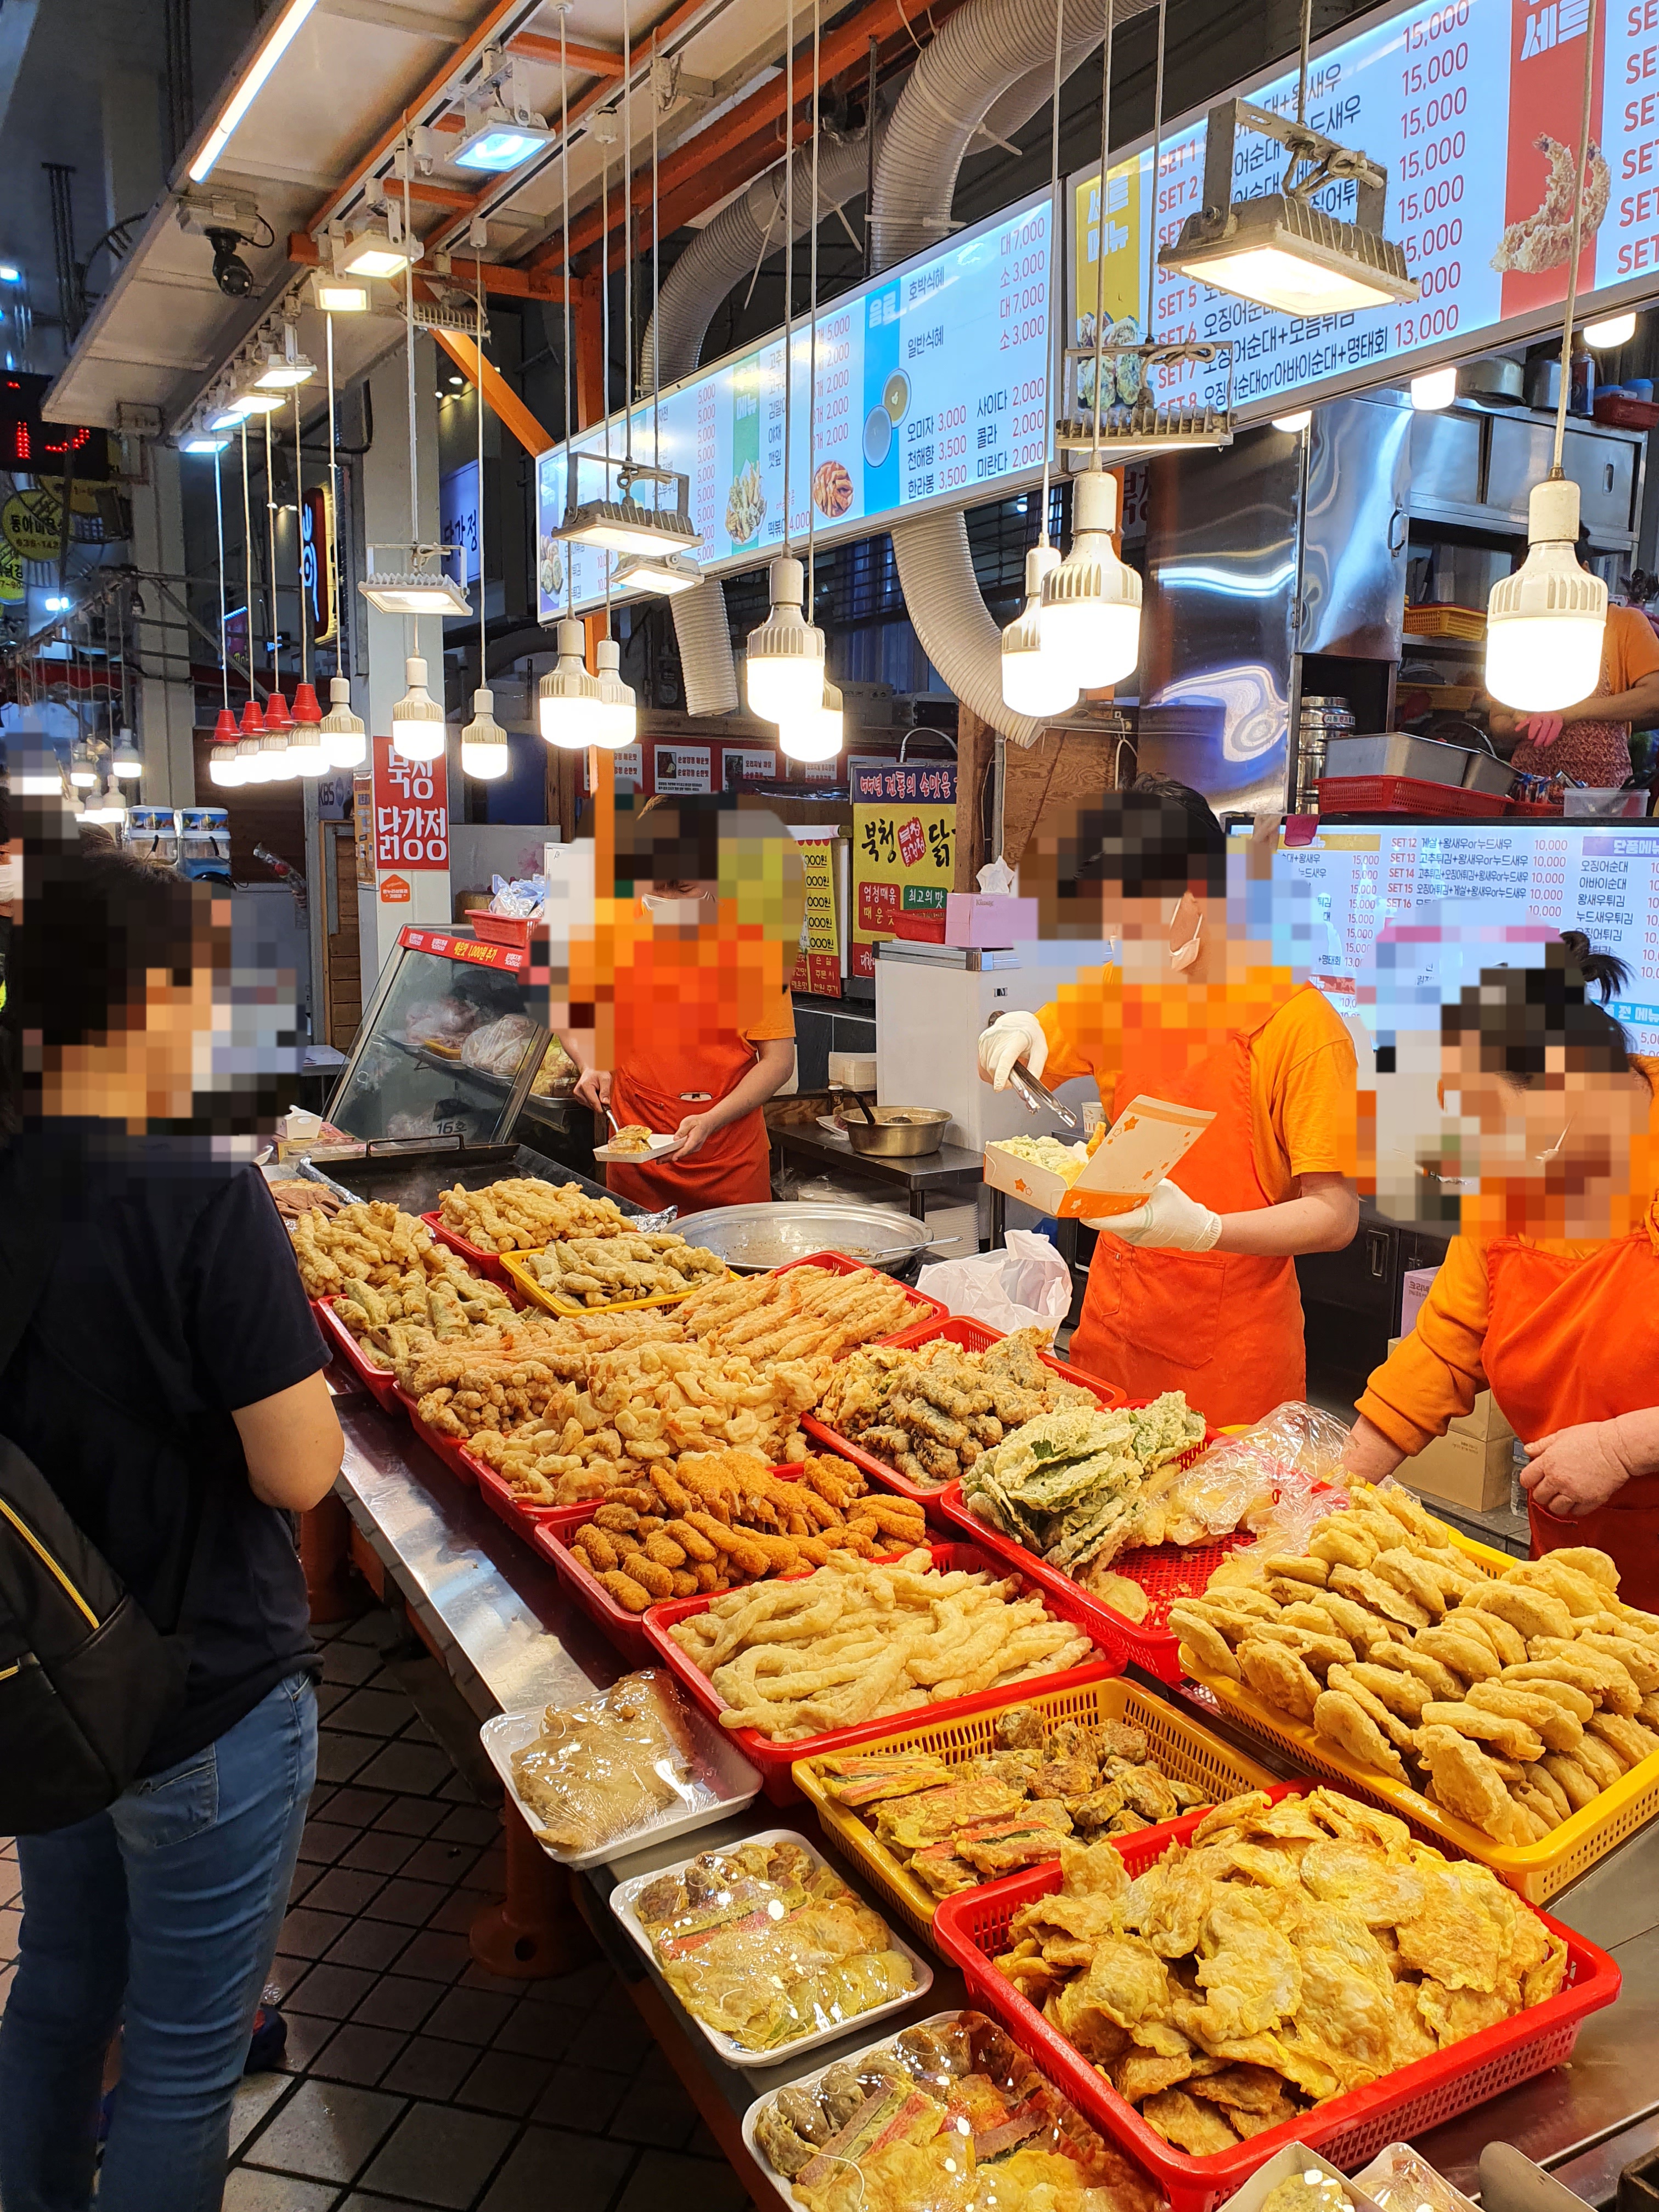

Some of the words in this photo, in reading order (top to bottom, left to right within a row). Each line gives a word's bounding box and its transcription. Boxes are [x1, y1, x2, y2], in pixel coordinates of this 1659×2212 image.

[1403, 0, 1469, 53] 15,000
[1627, 0, 1659, 37] SE
[1626, 44, 1659, 85] SE
[1401, 86, 1467, 139] 15,000
[1623, 92, 1659, 132] SE
[1159, 180, 1186, 214] SET
[1189, 176, 1198, 200] 2
[1402, 42, 1469, 97] 15,000
[1159, 144, 1186, 178] SET
[1189, 139, 1195, 162] 1
[1400, 131, 1465, 181] 15,000
[1158, 289, 1185, 319] SET
[1188, 285, 1197, 308] 5
[1398, 174, 1464, 224] 15,000
[1400, 218, 1462, 263] 5,000
[909, 266, 944, 301] 호박식혜
[1001, 232, 1011, 256] 대
[1014, 217, 1045, 250] 7,000
[1000, 267, 1011, 289] 소
[1013, 250, 1045, 283] 3,000
[827, 315, 850, 341] 5,000
[908, 325, 944, 359] 일반식혜
[1000, 295, 1011, 319] 대
[1013, 282, 1045, 314] 7,000
[1000, 329, 1010, 351] 소
[1013, 315, 1045, 345] 3,000
[1395, 304, 1459, 348] 13,000
[827, 342, 849, 368] 2,000
[698, 383, 715, 405] 5,000
[827, 369, 849, 394] 2,000
[697, 403, 715, 425] 5,000
[769, 424, 782, 443] 야채
[826, 396, 849, 420] 2,000
[907, 415, 934, 443] 오미자
[938, 405, 967, 432] 3,000
[977, 389, 1007, 418] 사이다
[1012, 377, 1045, 407] 2,000
[697, 424, 715, 444] 5,000
[826, 422, 848, 447] 2,000
[939, 435, 967, 461] 3,500
[977, 424, 997, 449] 콜라
[1012, 409, 1045, 437] 2,000
[697, 443, 715, 464] 5,000
[697, 464, 715, 484] 5,000
[909, 473, 934, 500] 한라봉
[939, 465, 967, 490] 3,500
[978, 450, 1007, 478] 미란다
[1012, 441, 1044, 468] 2,000
[697, 484, 715, 504] 5,000
[697, 504, 715, 523] 5,000
[789, 511, 810, 532] 4,000
[597, 551, 613, 569] 10,00
[697, 544, 714, 563] 5,000
[885, 771, 916, 798] 전통의
[919, 771, 951, 799] 손맛을
[378, 806, 447, 861] 닭강정
[861, 819, 896, 864] 북청
[928, 819, 956, 867] 닭
[1391, 838, 1408, 848] SET
[1408, 838, 1417, 848] 12
[1534, 840, 1568, 851] 10,000
[1353, 855, 1380, 865] 15,000
[1390, 853, 1407, 863] SET
[1407, 853, 1415, 864] 13
[1533, 856, 1566, 867] 10,000
[1581, 860, 1628, 873] 오징어순대
[1352, 870, 1378, 880] 15,000
[1389, 868, 1405, 878] SET
[1406, 868, 1415, 878] 14
[1531, 872, 1565, 884] 10,000
[1579, 877, 1627, 890] 아바이순대
[864, 885, 897, 905] 엄청매움
[909, 889, 933, 904] 최고의
[1350, 884, 1377, 895] 15,000
[1387, 883, 1404, 893] SET
[1404, 883, 1413, 893] 15
[1530, 889, 1563, 900] 10,000
[1578, 894, 1625, 907] 왕새우튀김
[1348, 913, 1374, 924] 15,000
[1349, 899, 1375, 909] 15,000
[1386, 898, 1402, 908] SET
[1403, 899, 1412, 909] 16
[1528, 905, 1562, 917] 10,000
[1576, 911, 1633, 925] 누드새우튀김
[1347, 928, 1373, 939] 15,000
[860, 952, 875, 971] 대한
[437, 1121, 467, 1135] 16호
